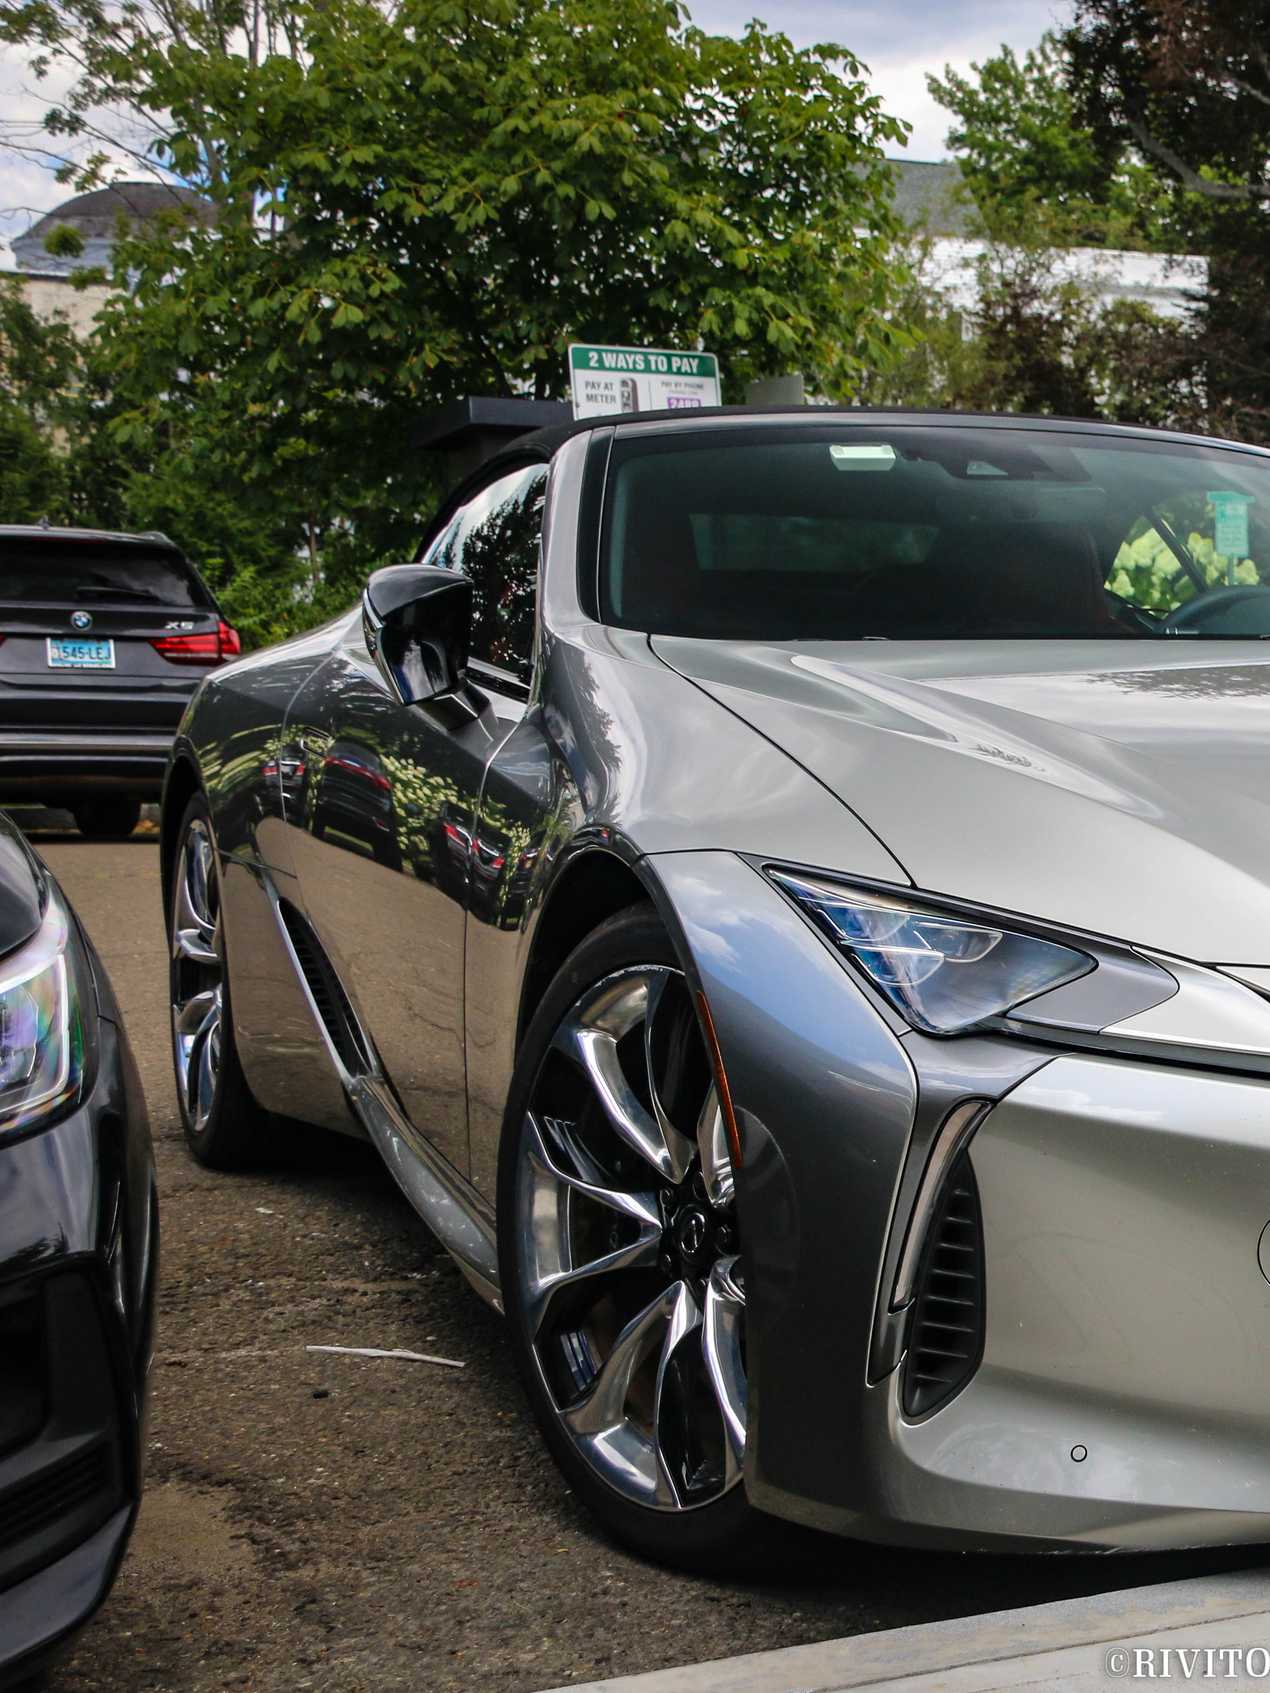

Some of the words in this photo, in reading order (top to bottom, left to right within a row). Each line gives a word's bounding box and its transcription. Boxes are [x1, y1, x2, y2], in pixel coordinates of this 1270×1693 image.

[588, 351, 599, 367] 2
[602, 352, 646, 371] WAYS
[649, 355, 668, 372] TO
[672, 357, 699, 373] PAY
[585, 381, 602, 391] PAY
[604, 382, 614, 391] AT
[684, 382, 704, 390] PHONE
[586, 394, 616, 405] METER
